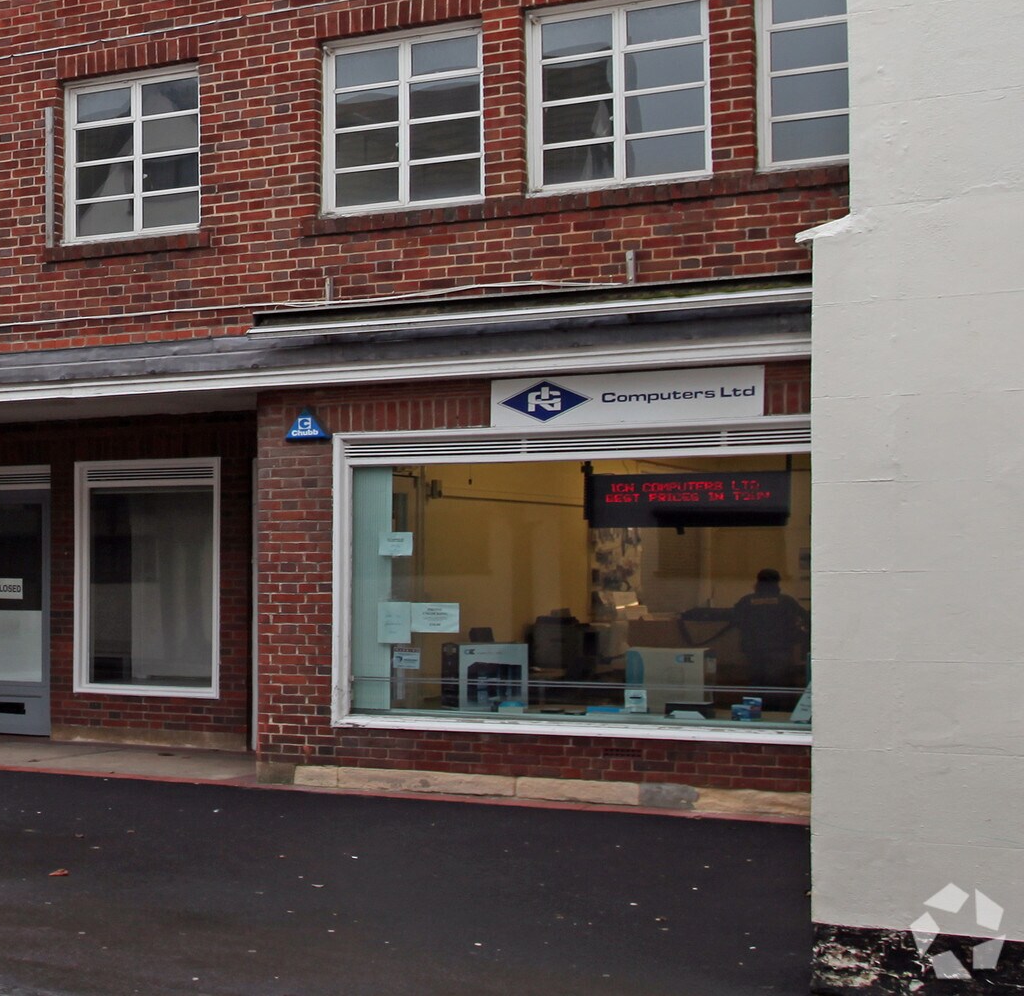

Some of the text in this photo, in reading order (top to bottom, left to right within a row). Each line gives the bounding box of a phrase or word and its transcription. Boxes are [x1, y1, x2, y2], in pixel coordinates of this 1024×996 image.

[602, 385, 756, 404] Computers Ltd
[291, 428, 319, 437] Chubb
[642, 481, 724, 493] COMPUTERS
[605, 492, 640, 503] BEST
[649, 491, 700, 503] PRICES
[708, 491, 724, 502] IN
